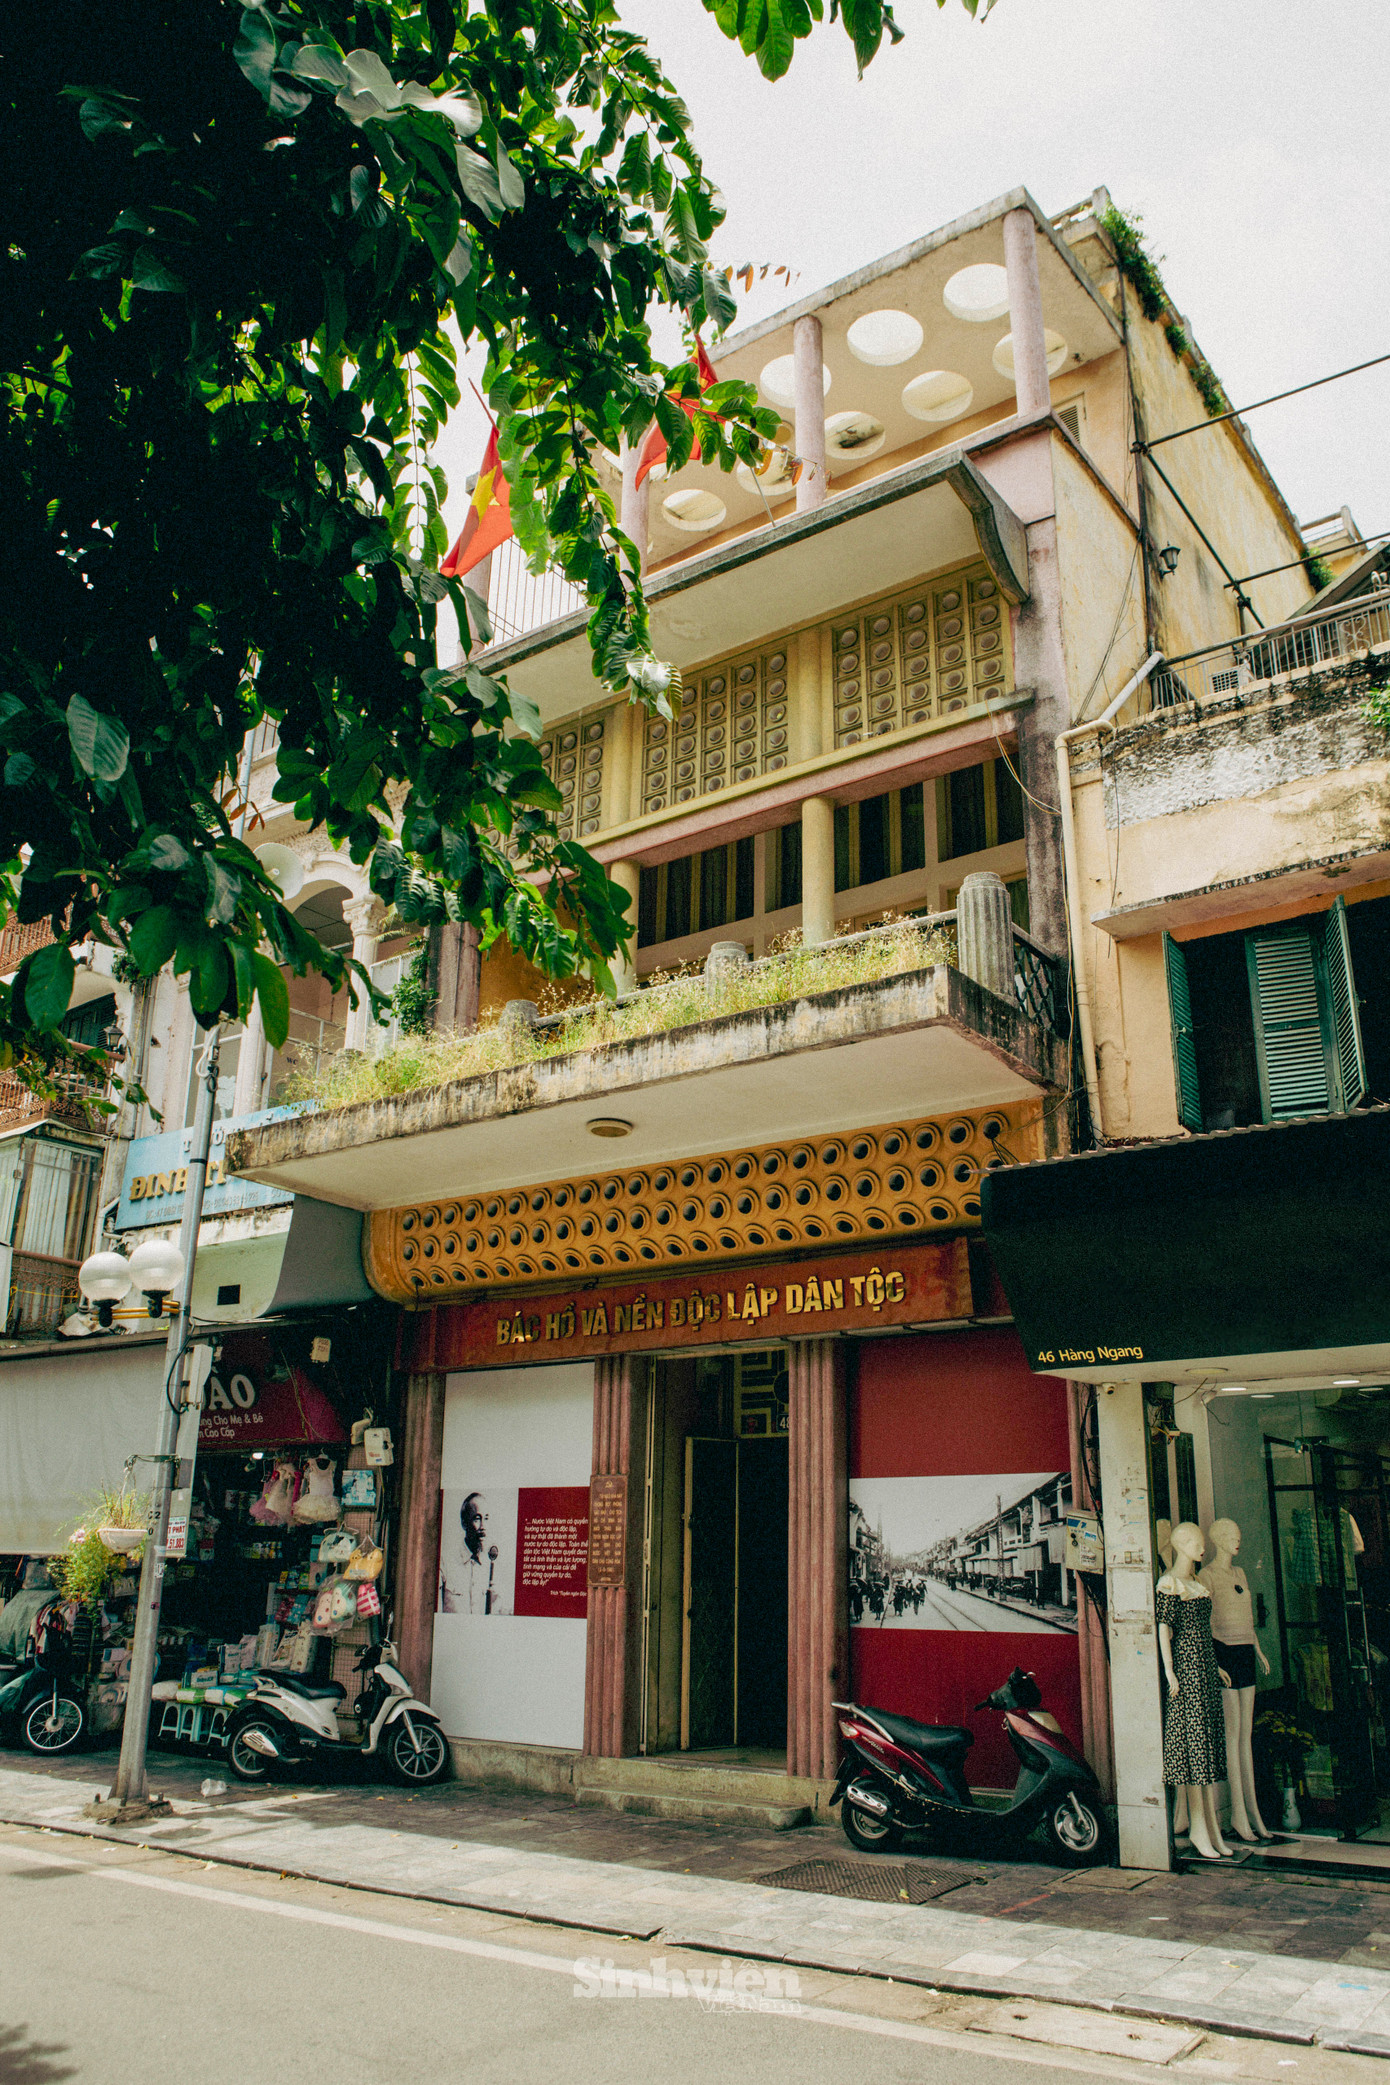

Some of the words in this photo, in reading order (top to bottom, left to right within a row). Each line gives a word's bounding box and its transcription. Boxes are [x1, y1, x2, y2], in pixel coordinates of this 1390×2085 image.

[496, 1311, 541, 1345] BÁC
[545, 1302, 575, 1340] HỒ
[581, 1302, 609, 1337] VÀ
[614, 1294, 664, 1333] NỀN
[669, 1289, 721, 1331] ĐỘC
[727, 1282, 778, 1325] LẬP
[786, 1276, 844, 1314] DÂN
[850, 1267, 905, 1312] TỘC
[1038, 1351, 1056, 1363] 46
[1059, 1348, 1095, 1363] Hàng
[1097, 1346, 1144, 1361] Ngang
[213, 1415, 229, 1425] Cho
[230, 1414, 243, 1427] Mẹ
[244, 1414, 252, 1424] &
[253, 1412, 264, 1424] Bé
